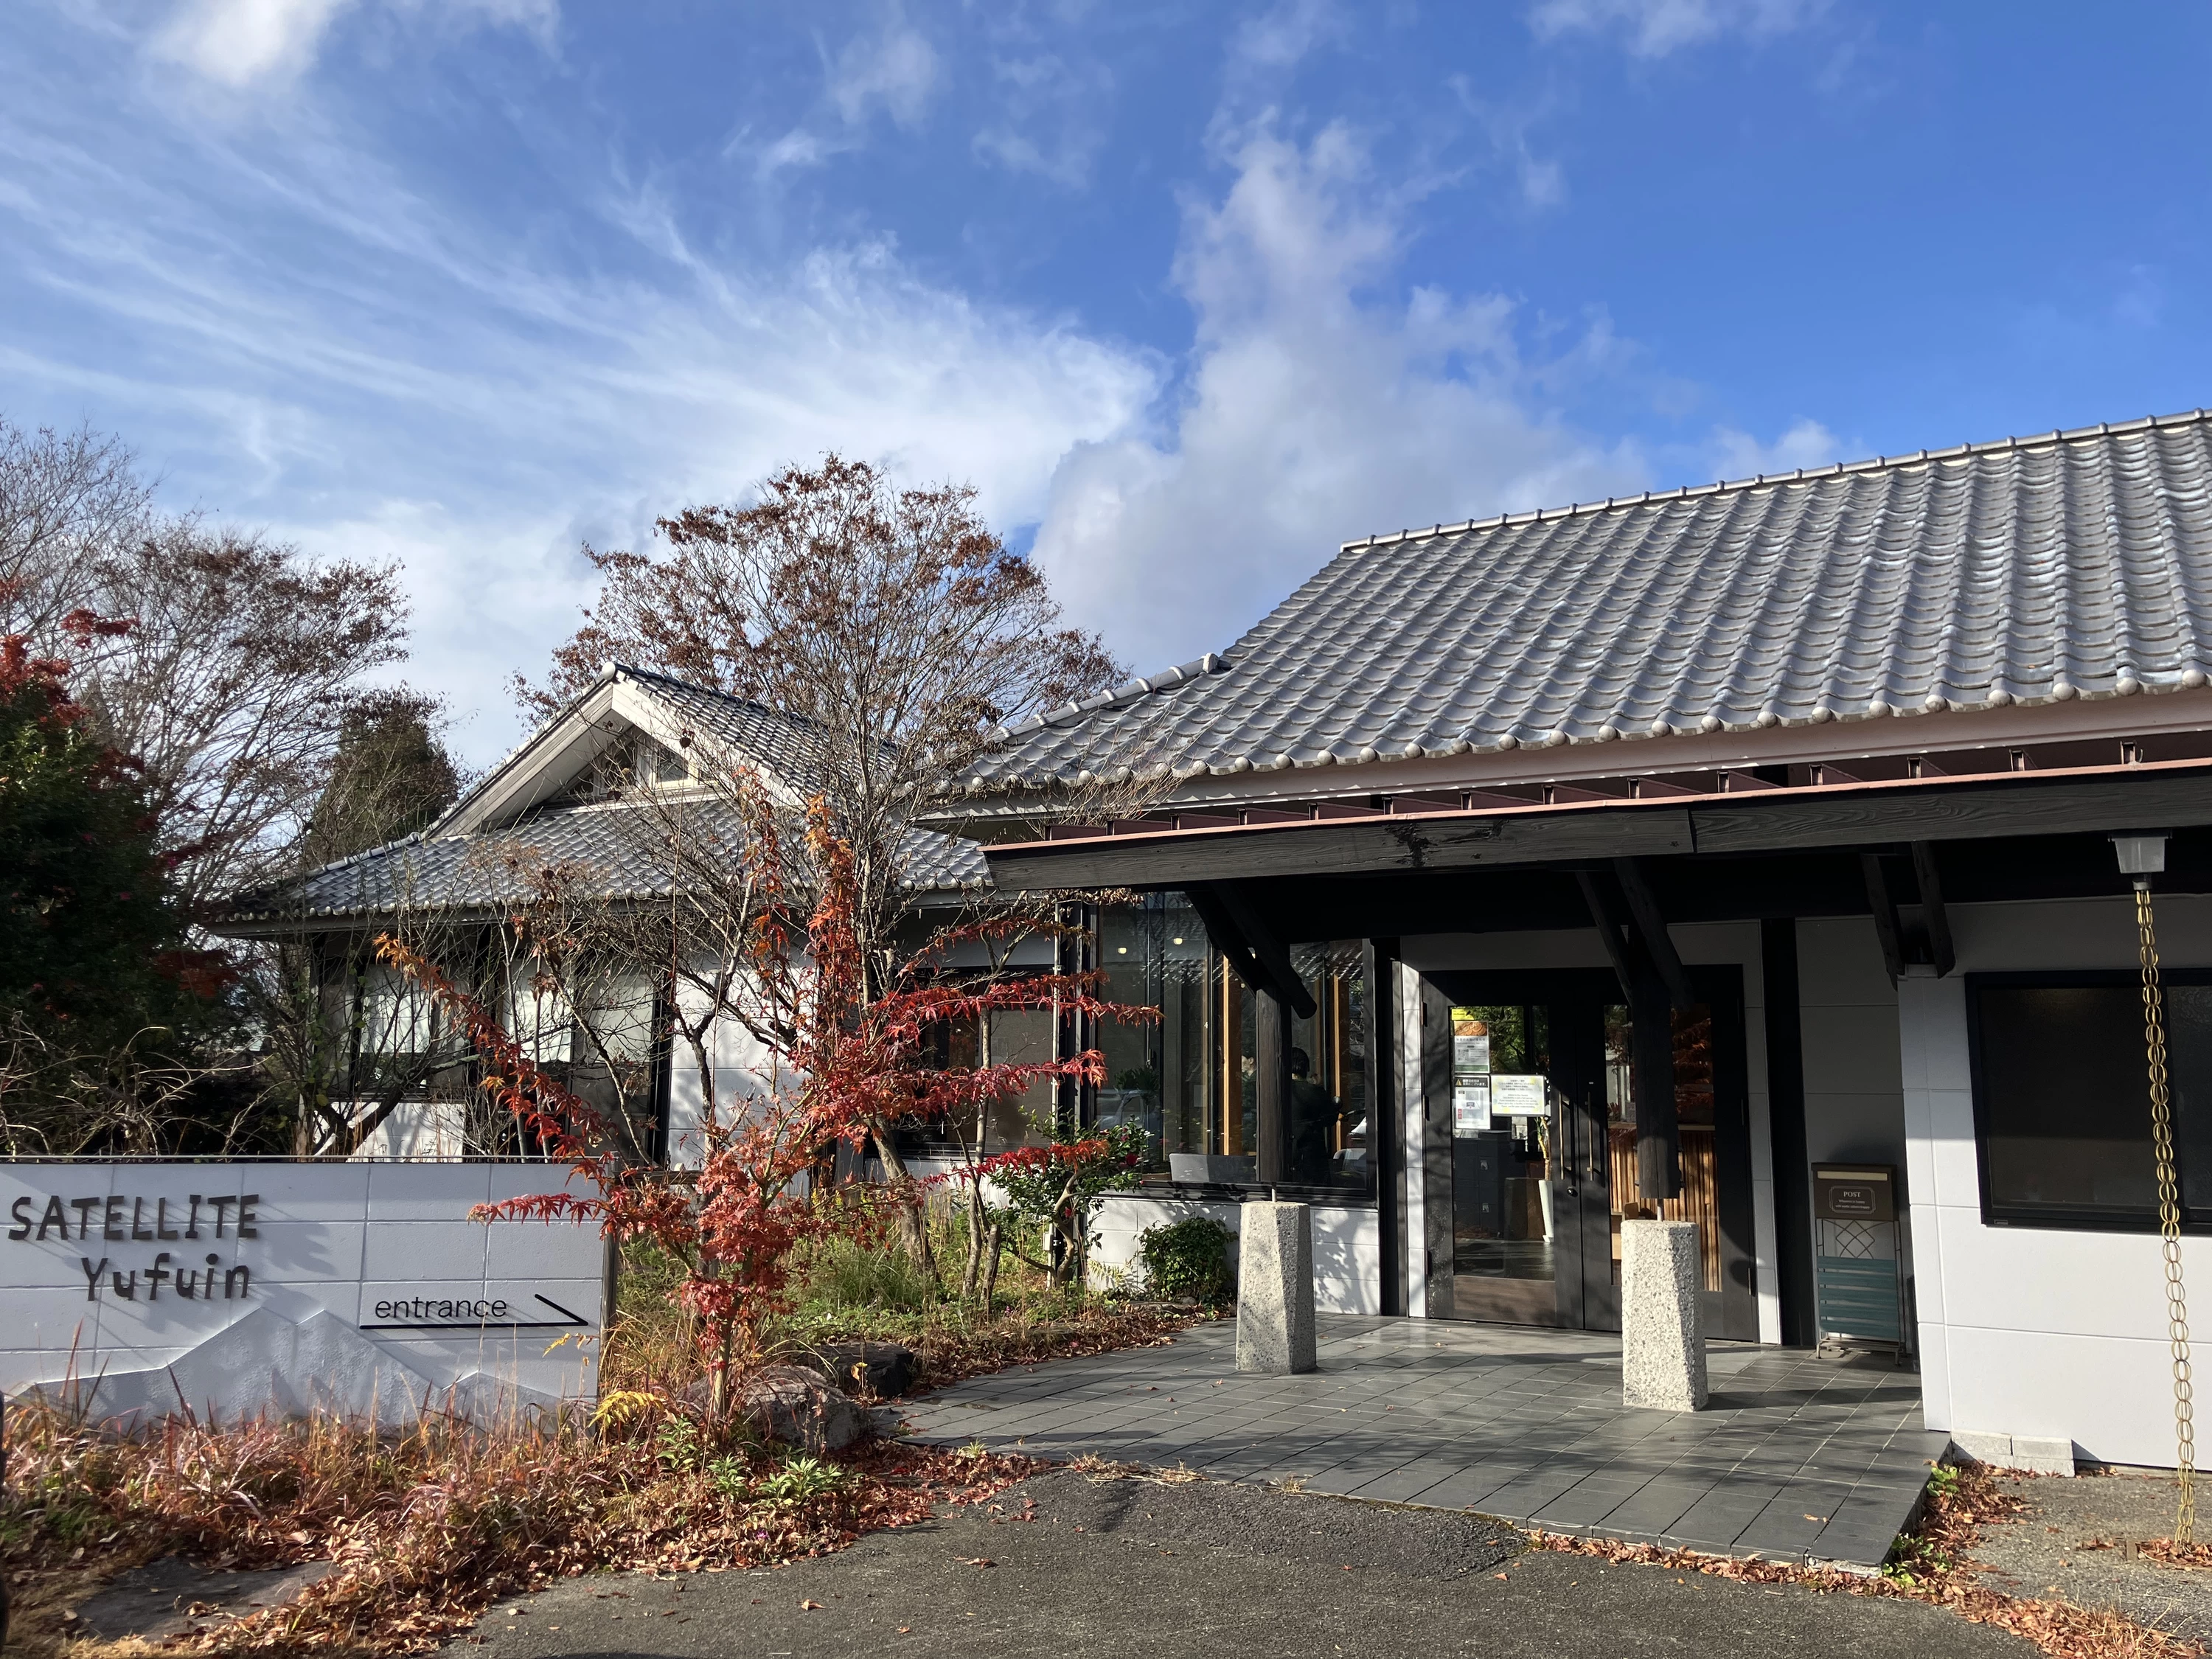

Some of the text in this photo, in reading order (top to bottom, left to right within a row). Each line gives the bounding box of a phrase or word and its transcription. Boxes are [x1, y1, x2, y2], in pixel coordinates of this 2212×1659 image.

[8, 1194, 259, 1240] SATELLITE
[80, 1253, 250, 1301] Yufuin
[375, 1296, 507, 1318] entrance
